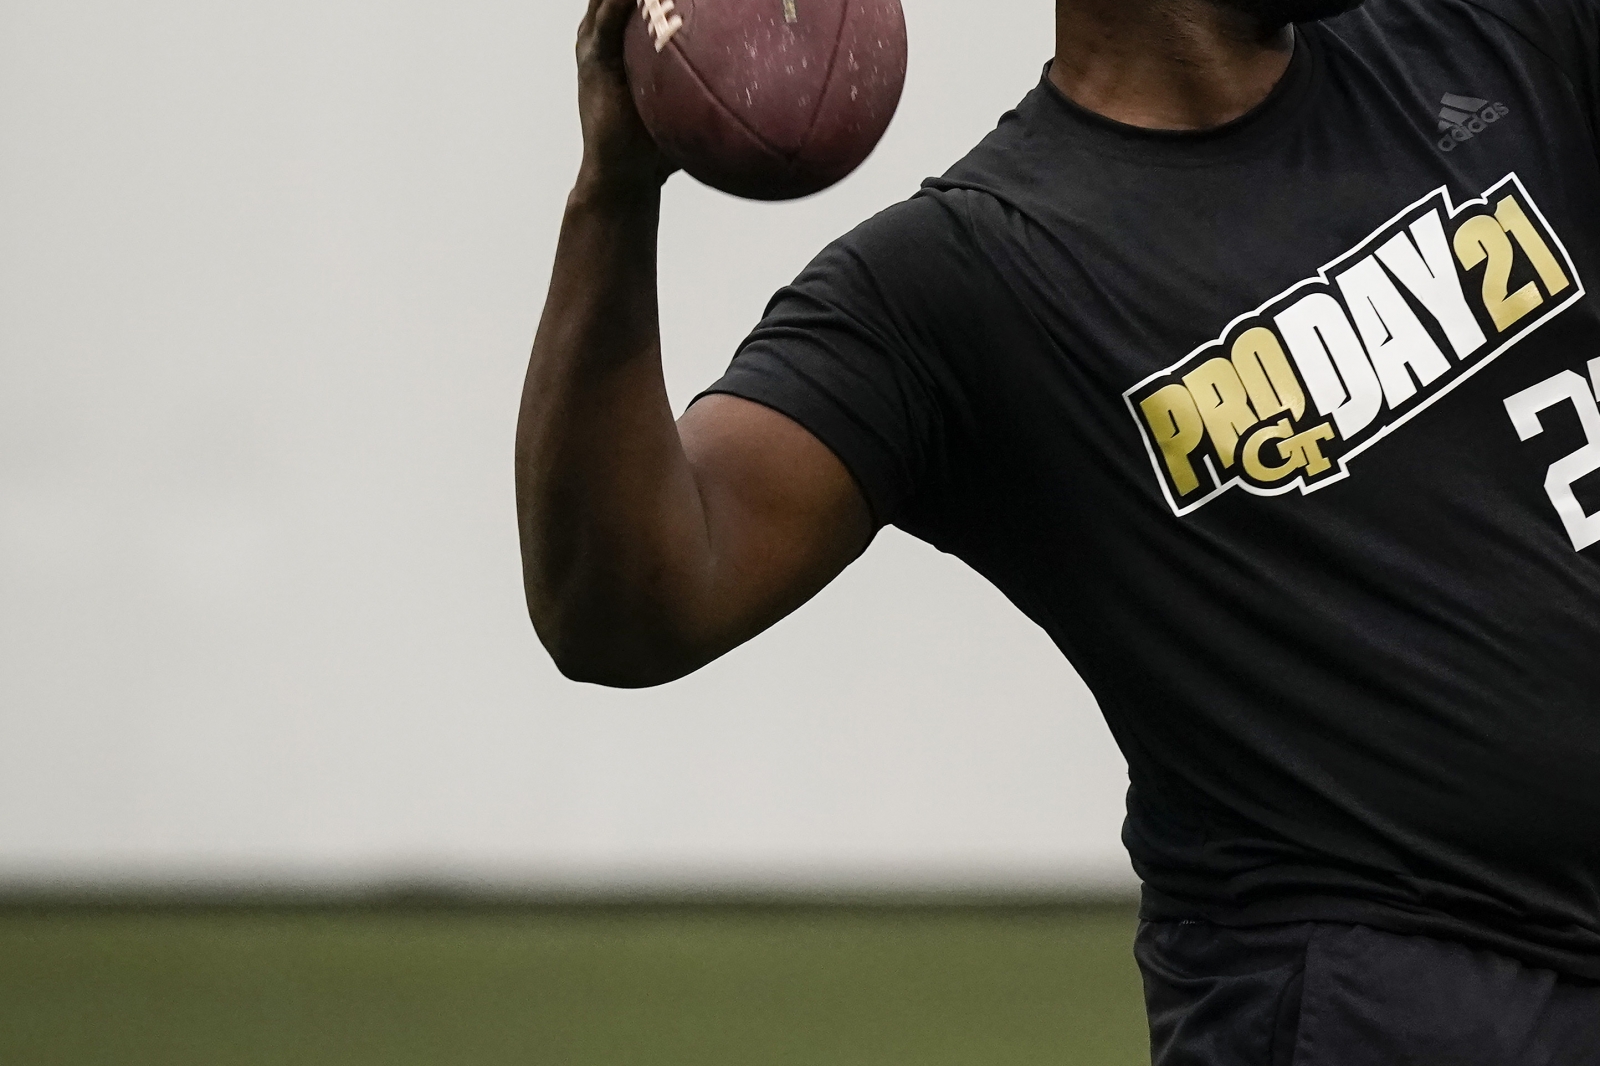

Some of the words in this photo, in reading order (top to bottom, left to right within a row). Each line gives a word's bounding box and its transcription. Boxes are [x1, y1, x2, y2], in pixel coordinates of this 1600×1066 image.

[1438, 102, 1509, 151] adidas
[1139, 326, 1306, 497] PRO
[1273, 209, 1487, 441] DAY
[1453, 194, 1569, 332] 21
[1242, 417, 1335, 482] GT
